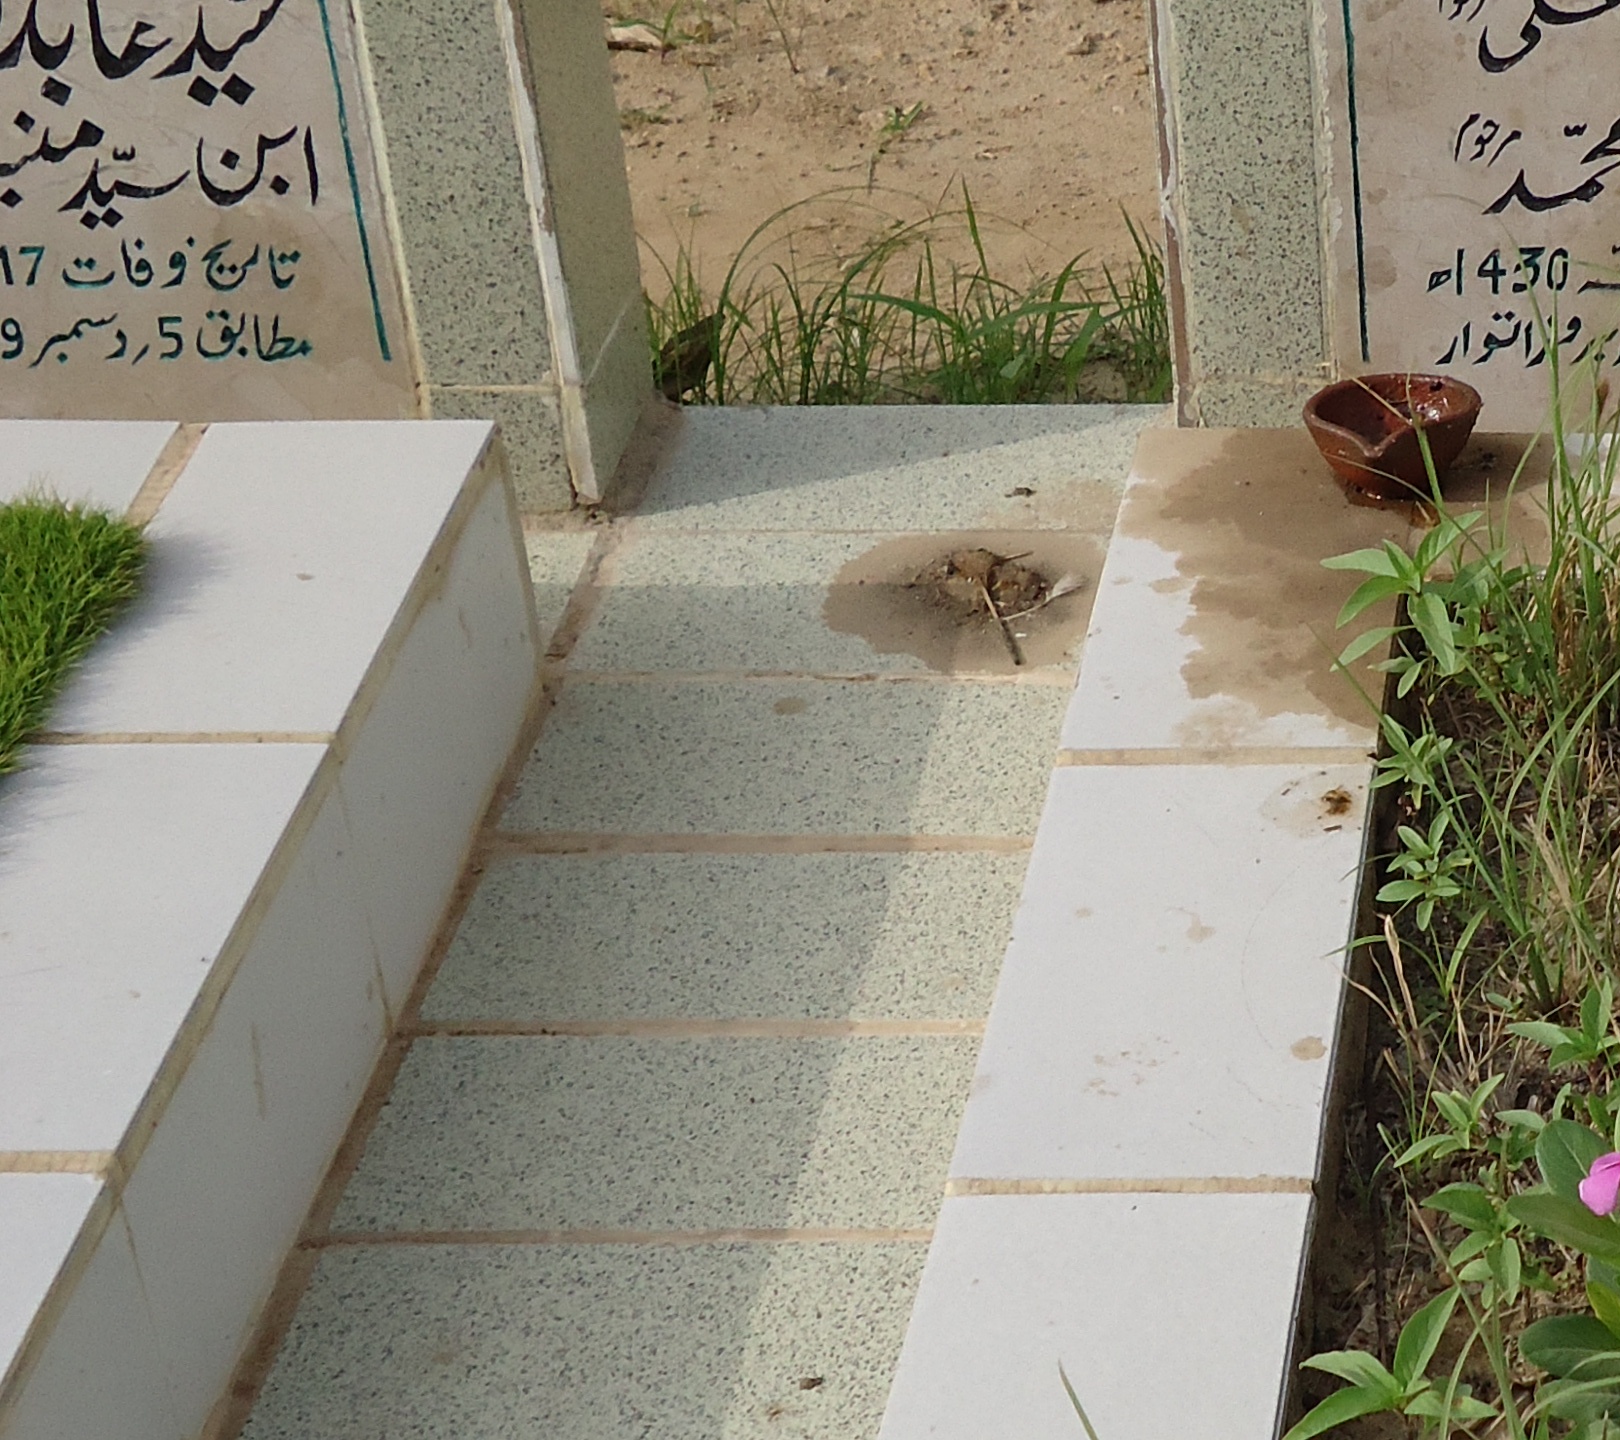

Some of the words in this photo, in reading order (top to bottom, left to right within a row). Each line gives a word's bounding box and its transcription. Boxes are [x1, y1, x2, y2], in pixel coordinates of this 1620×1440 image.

[58, 146, 191, 230] سید
[197, 125, 319, 208] ابن
[62, 237, 187, 289] وفات
[188, 237, 301, 292] تاریخ
[29, 313, 128, 368] دسمبر
[197, 310, 312, 363] مطابق
[1435, 311, 1533, 366] اتوار
